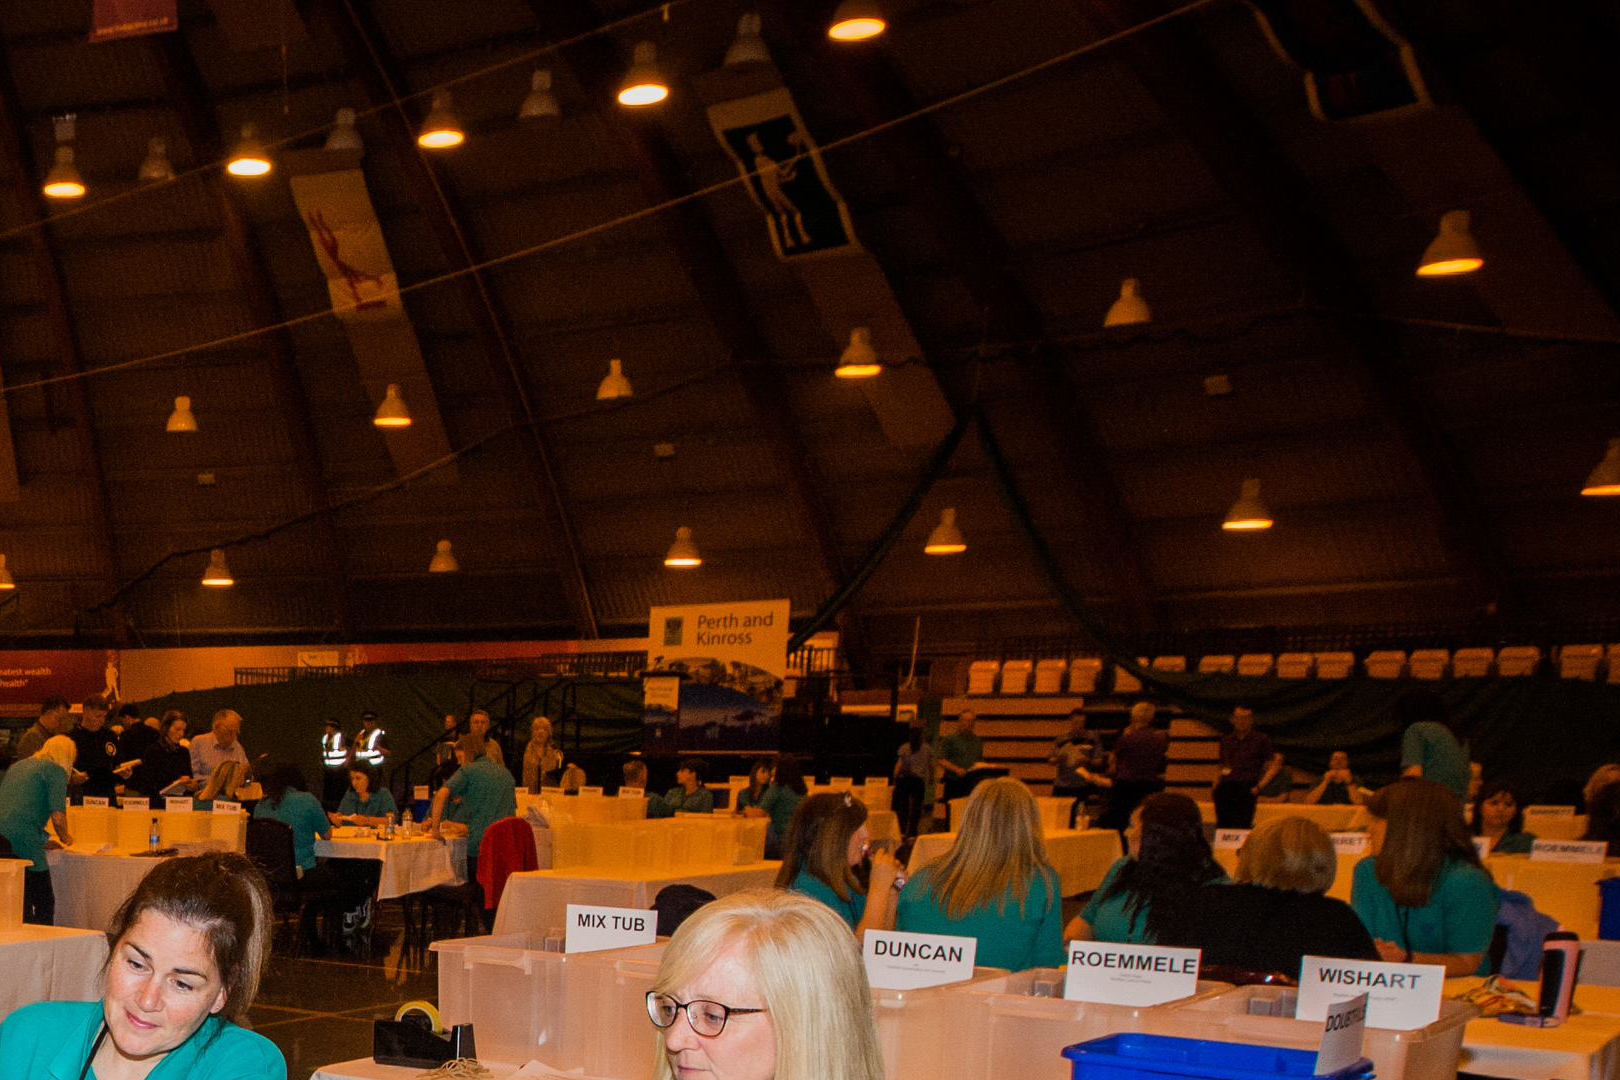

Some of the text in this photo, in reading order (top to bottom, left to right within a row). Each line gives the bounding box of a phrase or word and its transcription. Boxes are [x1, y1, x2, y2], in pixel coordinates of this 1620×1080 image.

[697, 611, 773, 630] Perth and
[697, 630, 753, 645] Kinross
[23, 666, 52, 677] wealth
[1222, 833, 1241, 841] MIX
[577, 913, 645, 933] MIX TUB
[874, 939, 964, 963] DUNCAN
[1071, 950, 1198, 975] ROEMMELE
[1319, 967, 1421, 990] WISHART
